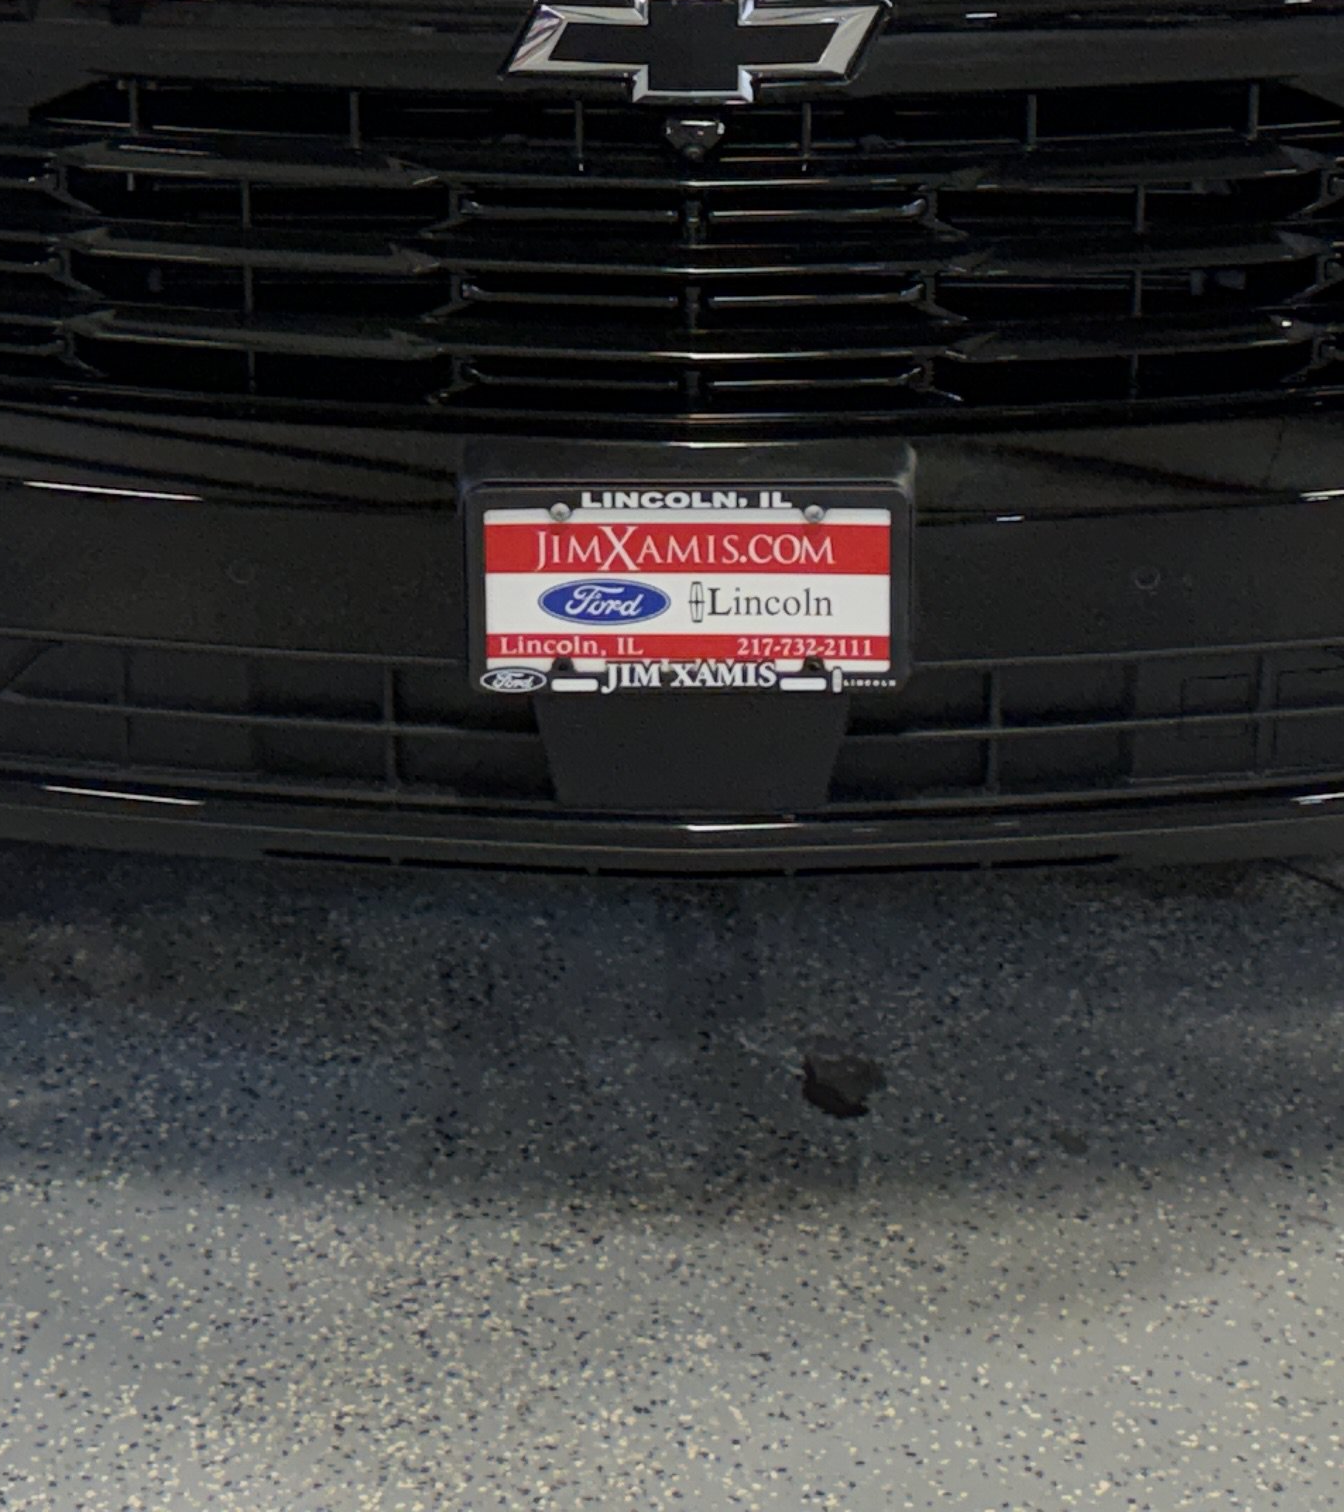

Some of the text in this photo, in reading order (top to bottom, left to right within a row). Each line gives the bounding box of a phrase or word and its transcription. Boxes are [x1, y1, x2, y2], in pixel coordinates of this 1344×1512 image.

[581, 491, 792, 509] LINCOLN, IL
[564, 584, 643, 618] Ford
[707, 587, 833, 617] Lincoln
[499, 636, 644, 657] Lincoln, IL
[737, 638, 873, 657] 217-732-2111
[601, 661, 777, 695] JIM XAMIS
